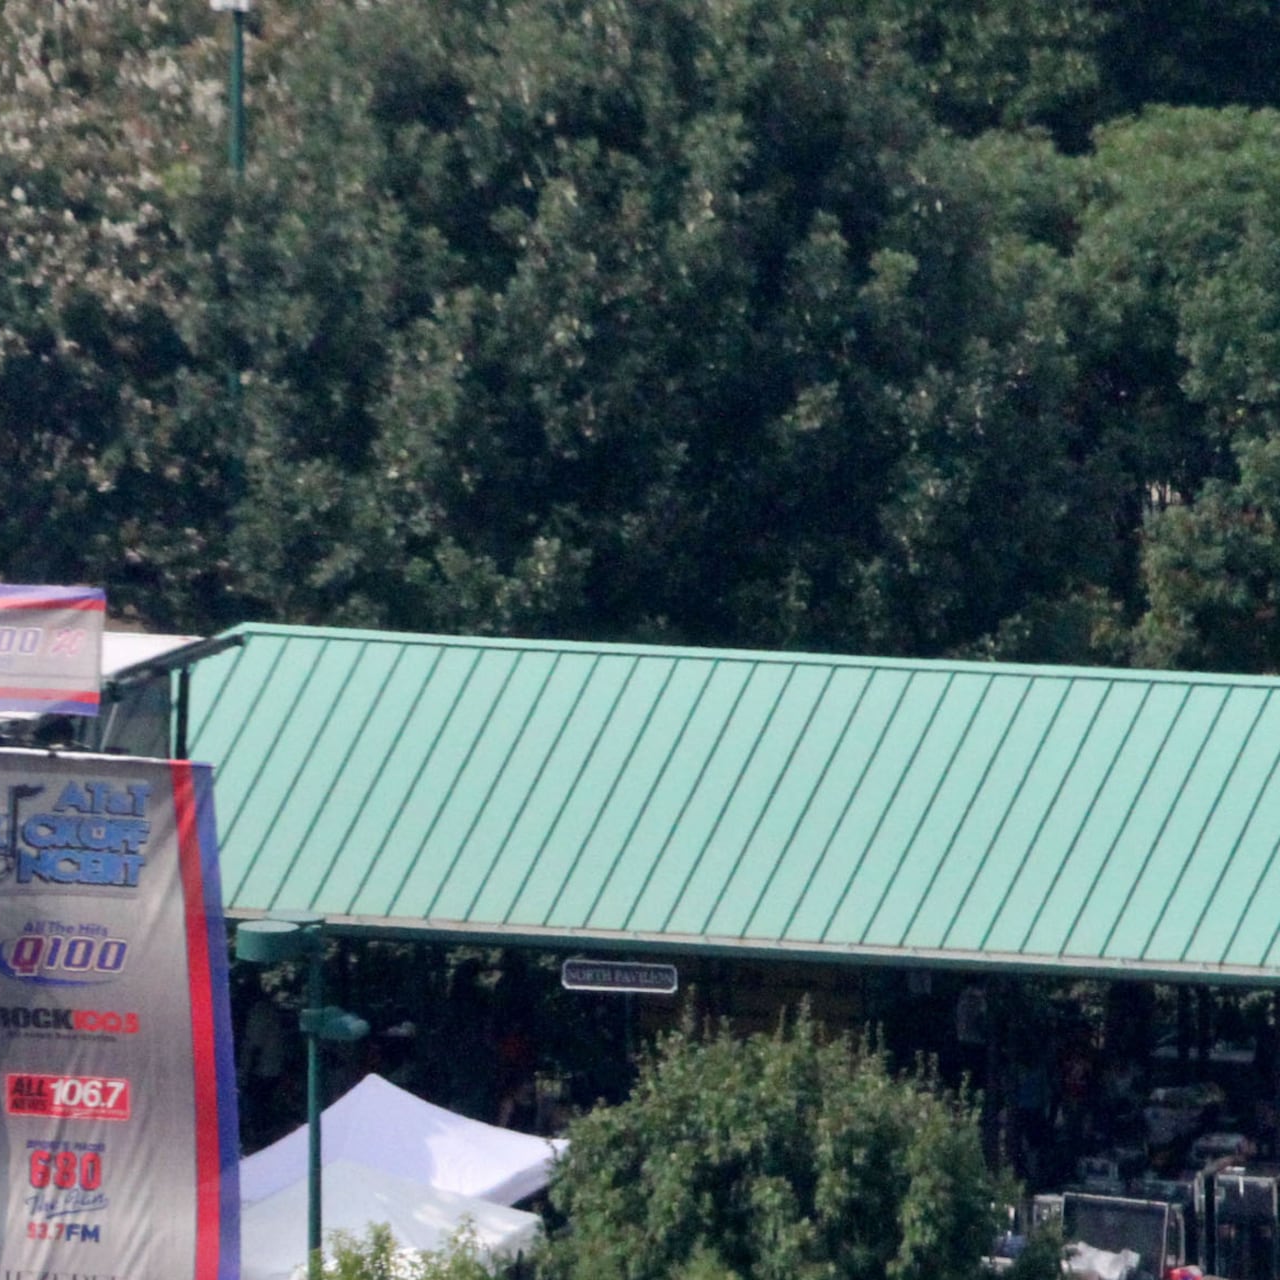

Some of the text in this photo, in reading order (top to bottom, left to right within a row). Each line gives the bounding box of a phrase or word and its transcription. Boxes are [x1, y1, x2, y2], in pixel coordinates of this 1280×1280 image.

[24, 921, 44, 933] All
[48, 920, 74, 935] The
[10, 935, 127, 976] Q100
[13, 1077, 47, 1097] ALL
[51, 1079, 125, 1109] 106.7
[30, 1150, 102, 1191] 680
[27, 1223, 101, 1243] 93.7FM
